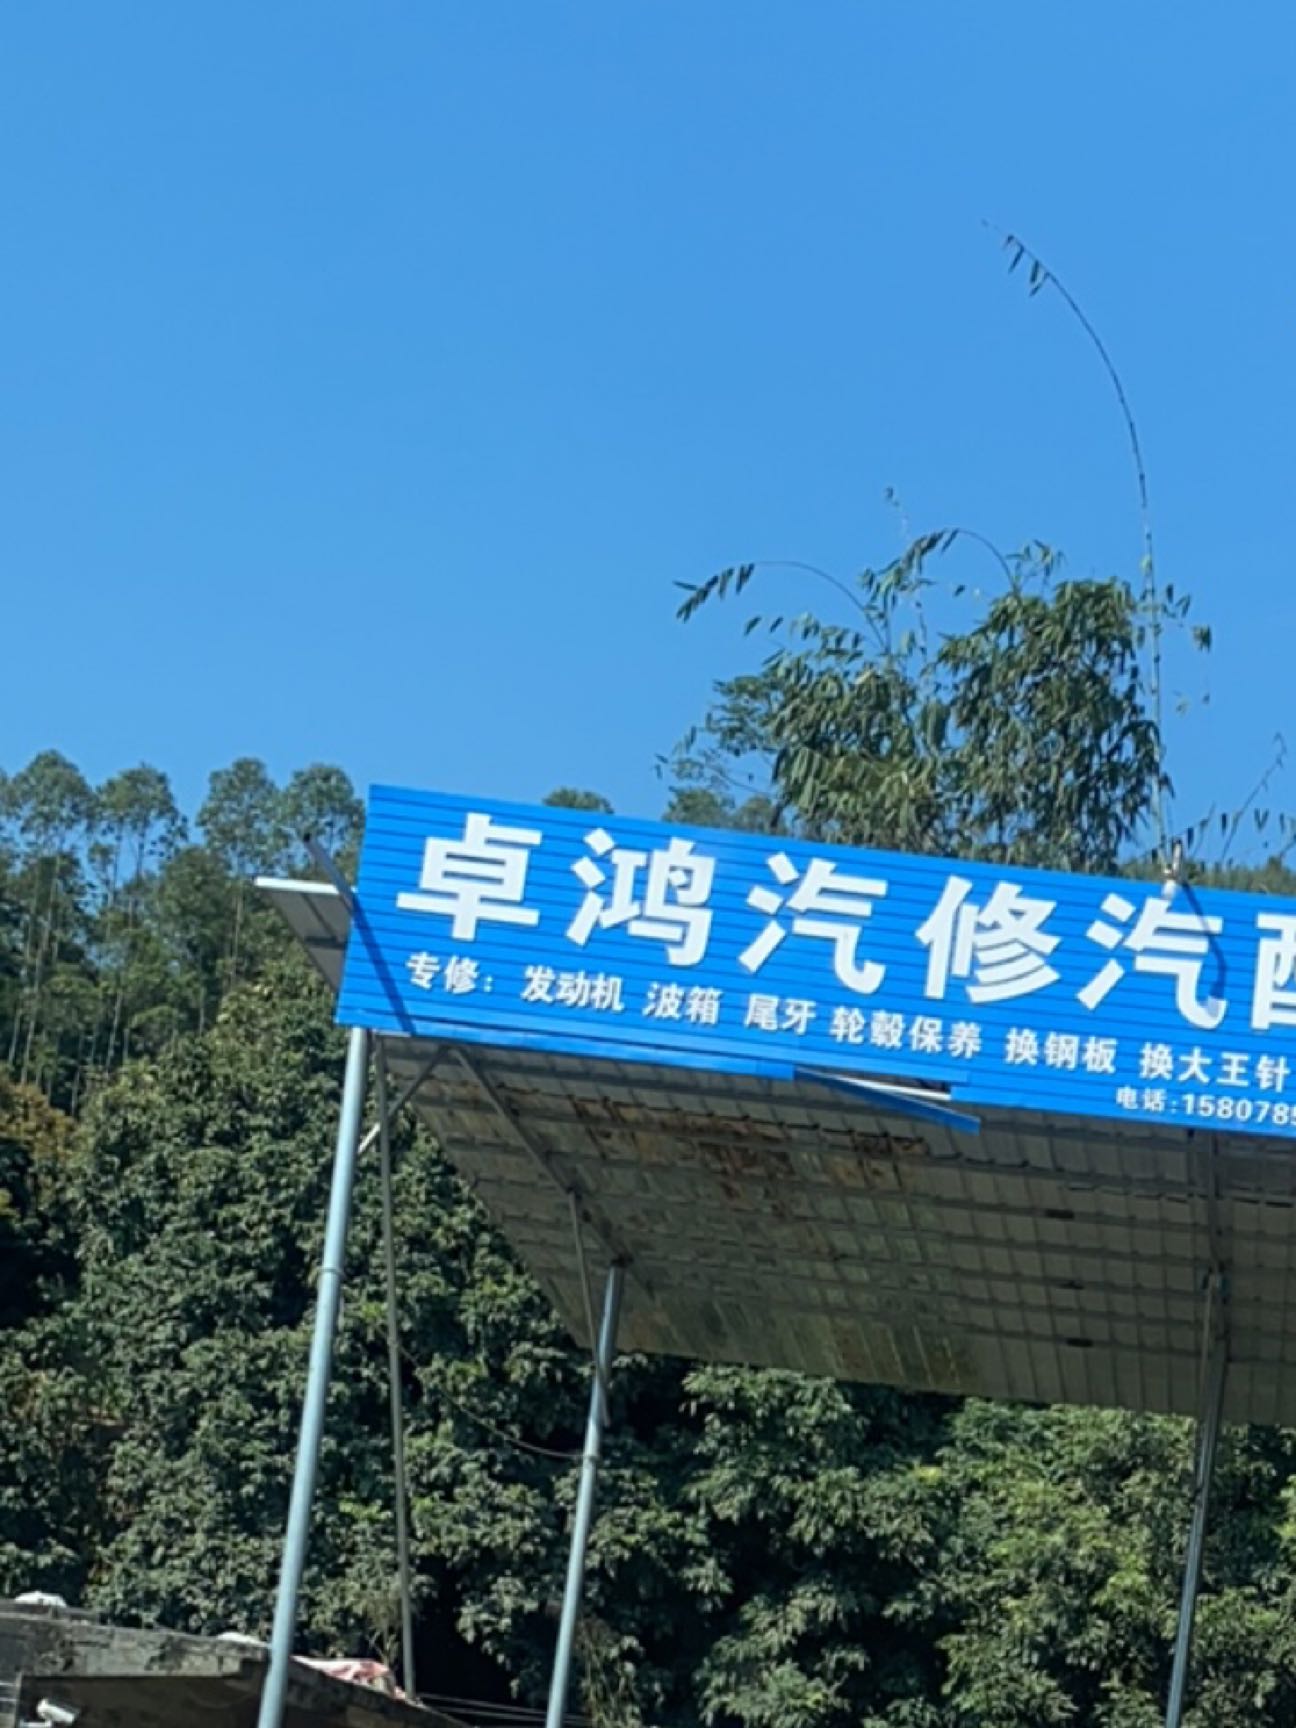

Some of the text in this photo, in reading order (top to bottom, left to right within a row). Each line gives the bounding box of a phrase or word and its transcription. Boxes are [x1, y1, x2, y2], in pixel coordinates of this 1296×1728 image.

[521, 964, 624, 1012] 发动机
[642, 981, 723, 1026] 波箱
[744, 993, 816, 1035] 尾牙
[830, 1006, 983, 1059] 轮毂保养
[1005, 1028, 1117, 1074] 换钢板
[1139, 1042, 1291, 1094] 换大王针
